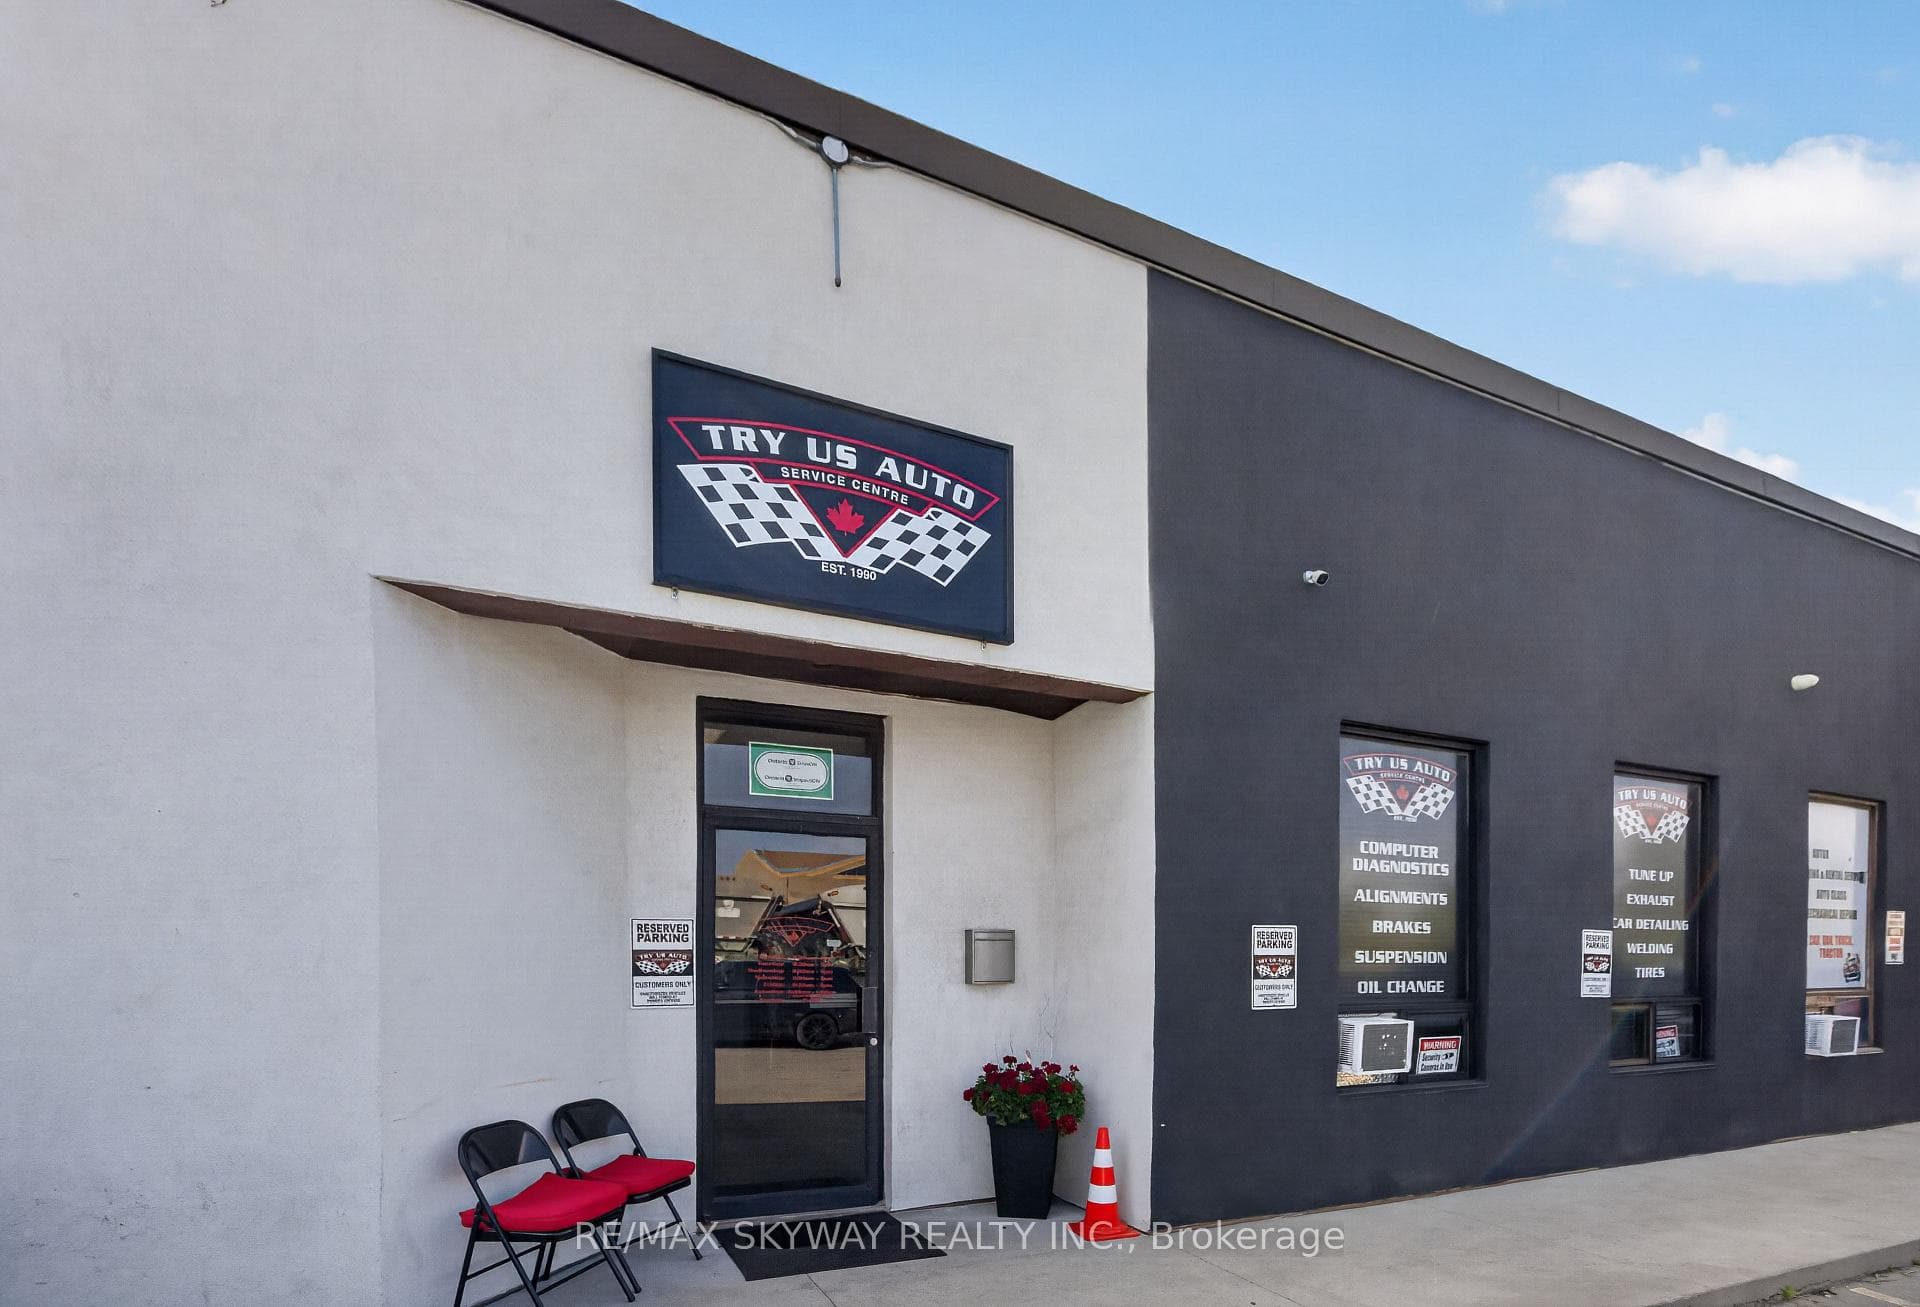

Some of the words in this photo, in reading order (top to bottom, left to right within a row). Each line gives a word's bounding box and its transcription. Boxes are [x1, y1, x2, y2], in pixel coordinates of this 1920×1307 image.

[701, 424, 786, 456] TRY
[806, 436, 857, 470] US
[874, 455, 976, 511] AUTO
[780, 466, 846, 488] SERVICE
[851, 479, 909, 505] CENTRE
[821, 561, 847, 577] EST.
[850, 566, 877, 582] 1990
[1354, 756, 1384, 771] TRY
[1389, 757, 1408, 771] US
[1413, 761, 1451, 783] AUTO
[1617, 789, 1639, 801] TRY
[1643, 789, 1657, 800] US
[1660, 792, 1688, 810] AUTO
[1359, 840, 1440, 859] COMPUTER
[1352, 857, 1450, 877] DIAGNOSTICS
[1628, 868, 1657, 881] TUNE
[1659, 870, 1674, 882] UP
[1354, 888, 1448, 906] ALIGNMENTS
[1626, 893, 1675, 906] EXHAUST
[636, 923, 690, 933] RESERVED
[1372, 920, 1432, 935] BRAKES
[1635, 918, 1689, 931] DETAILING
[636, 933, 690, 943] PARKING
[1256, 931, 1293, 940] RESERVED
[1256, 940, 1293, 949] PARKING
[1626, 942, 1674, 954] WELDING
[1354, 950, 1448, 964] SUSPENSION
[1634, 967, 1665, 978] TIRES
[635, 981, 674, 989] CUSTOMERS
[1357, 980, 1382, 994] OIL
[1387, 980, 1445, 994] CHANGE
